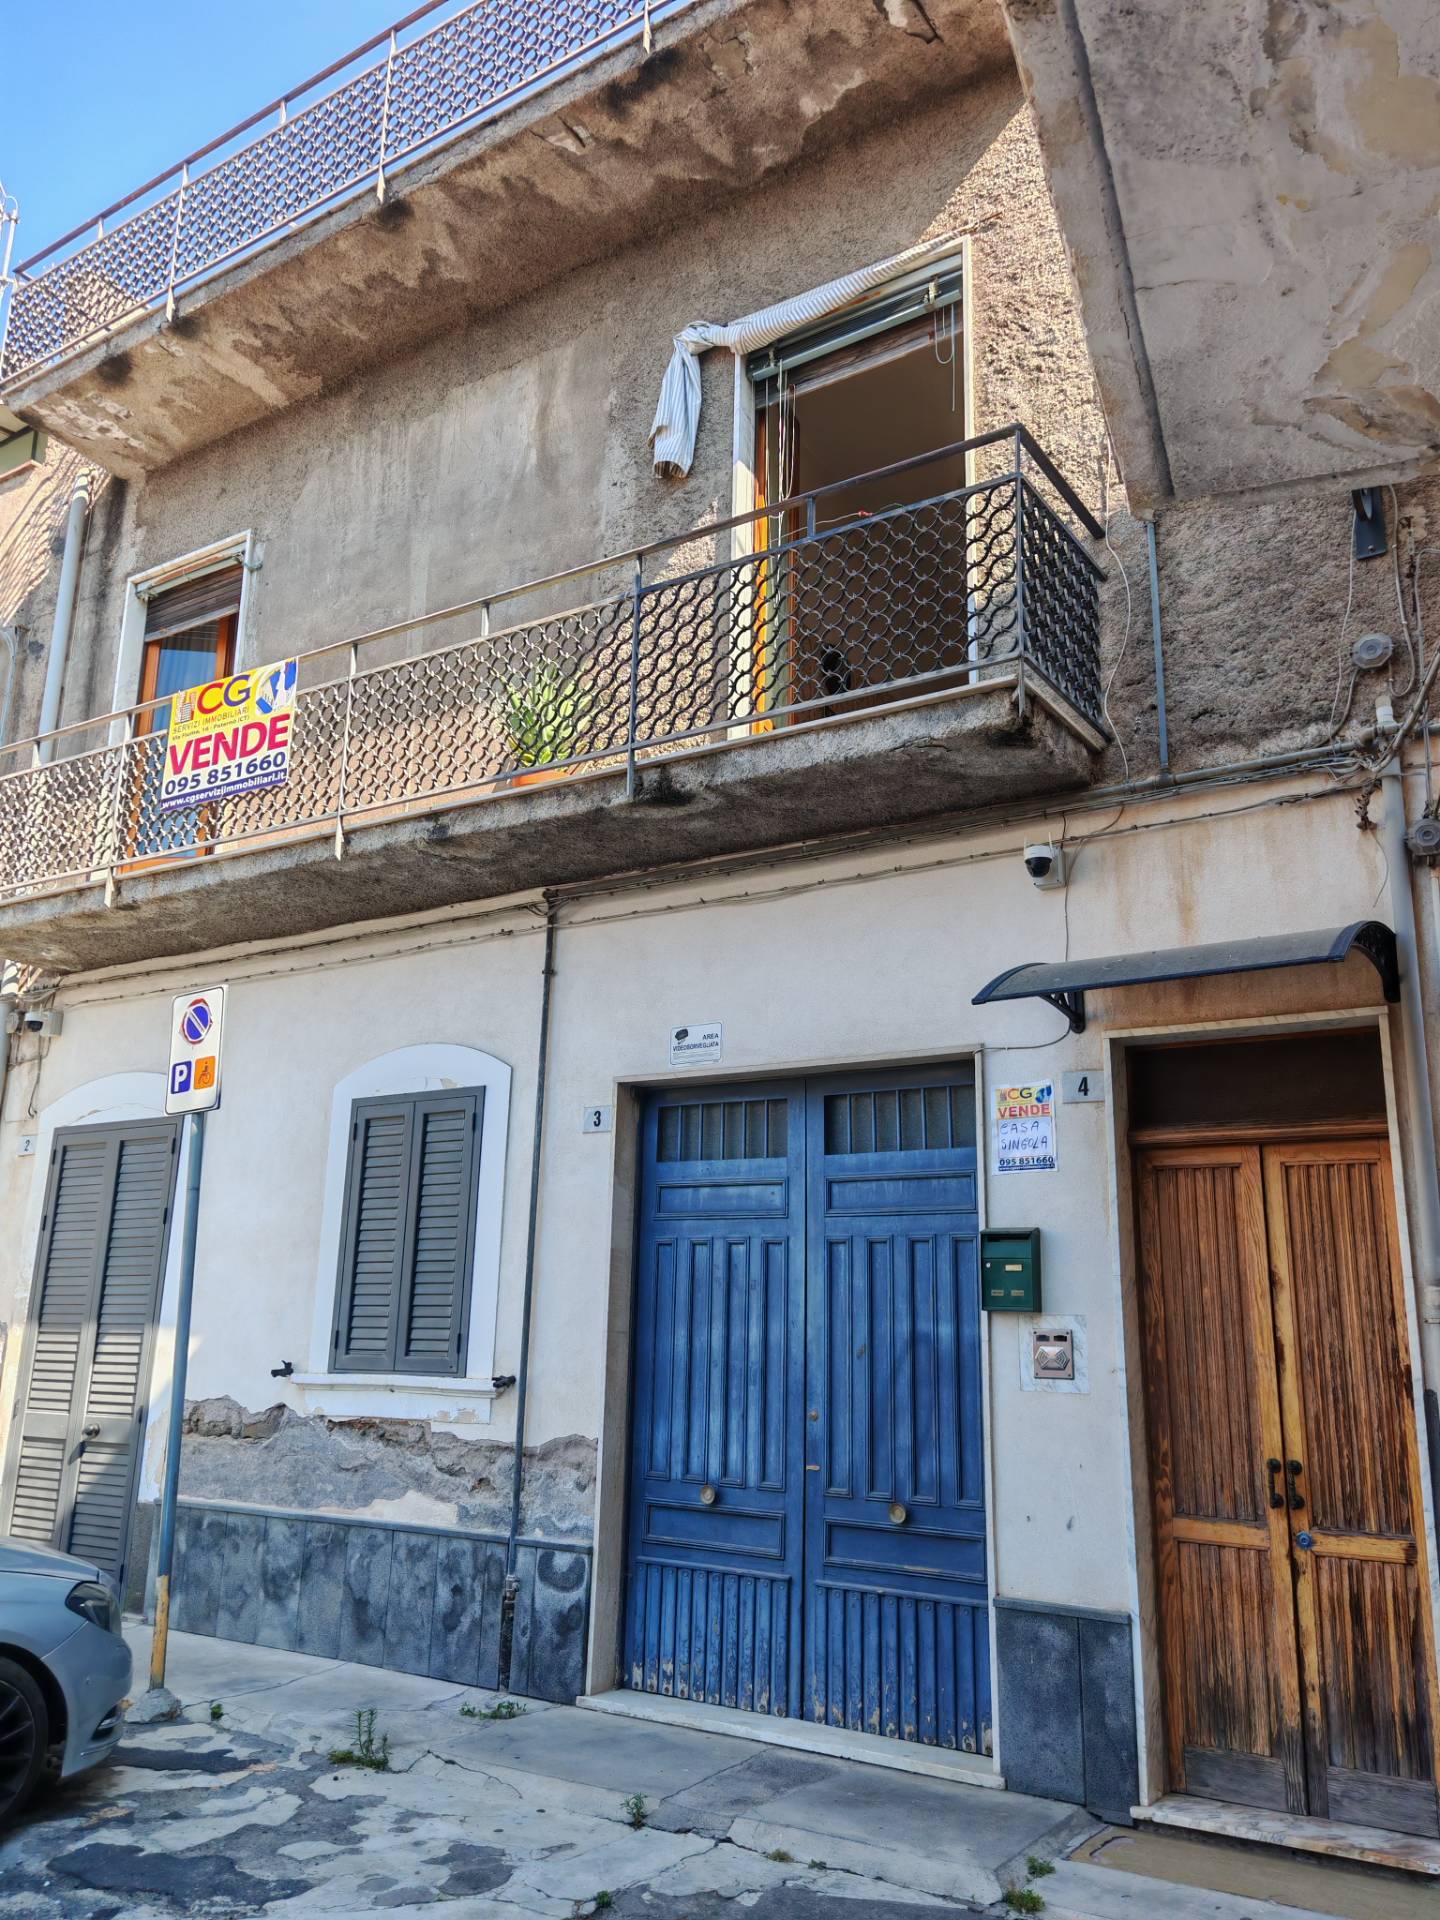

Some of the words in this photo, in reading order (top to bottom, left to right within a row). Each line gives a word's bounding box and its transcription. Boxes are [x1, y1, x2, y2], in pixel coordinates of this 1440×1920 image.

[197, 674, 251, 714] CG
[169, 713, 291, 775] VENDE
[165, 774, 200, 796] 095
[207, 751, 286, 785] 851660
[174, 1064, 188, 1092] P
[1078, 1076, 1089, 1096] 4
[1007, 1087, 1032, 1100] CG
[593, 1110, 601, 1127] 3
[998, 1103, 1050, 1118] VENDE
[1000, 1120, 1039, 1134] CASA
[24, 1139, 31, 1152] 2
[1001, 1135, 1048, 1150] SINGOLA
[999, 1158, 1016, 1166] 095
[1018, 1156, 1054, 1165] 851660
